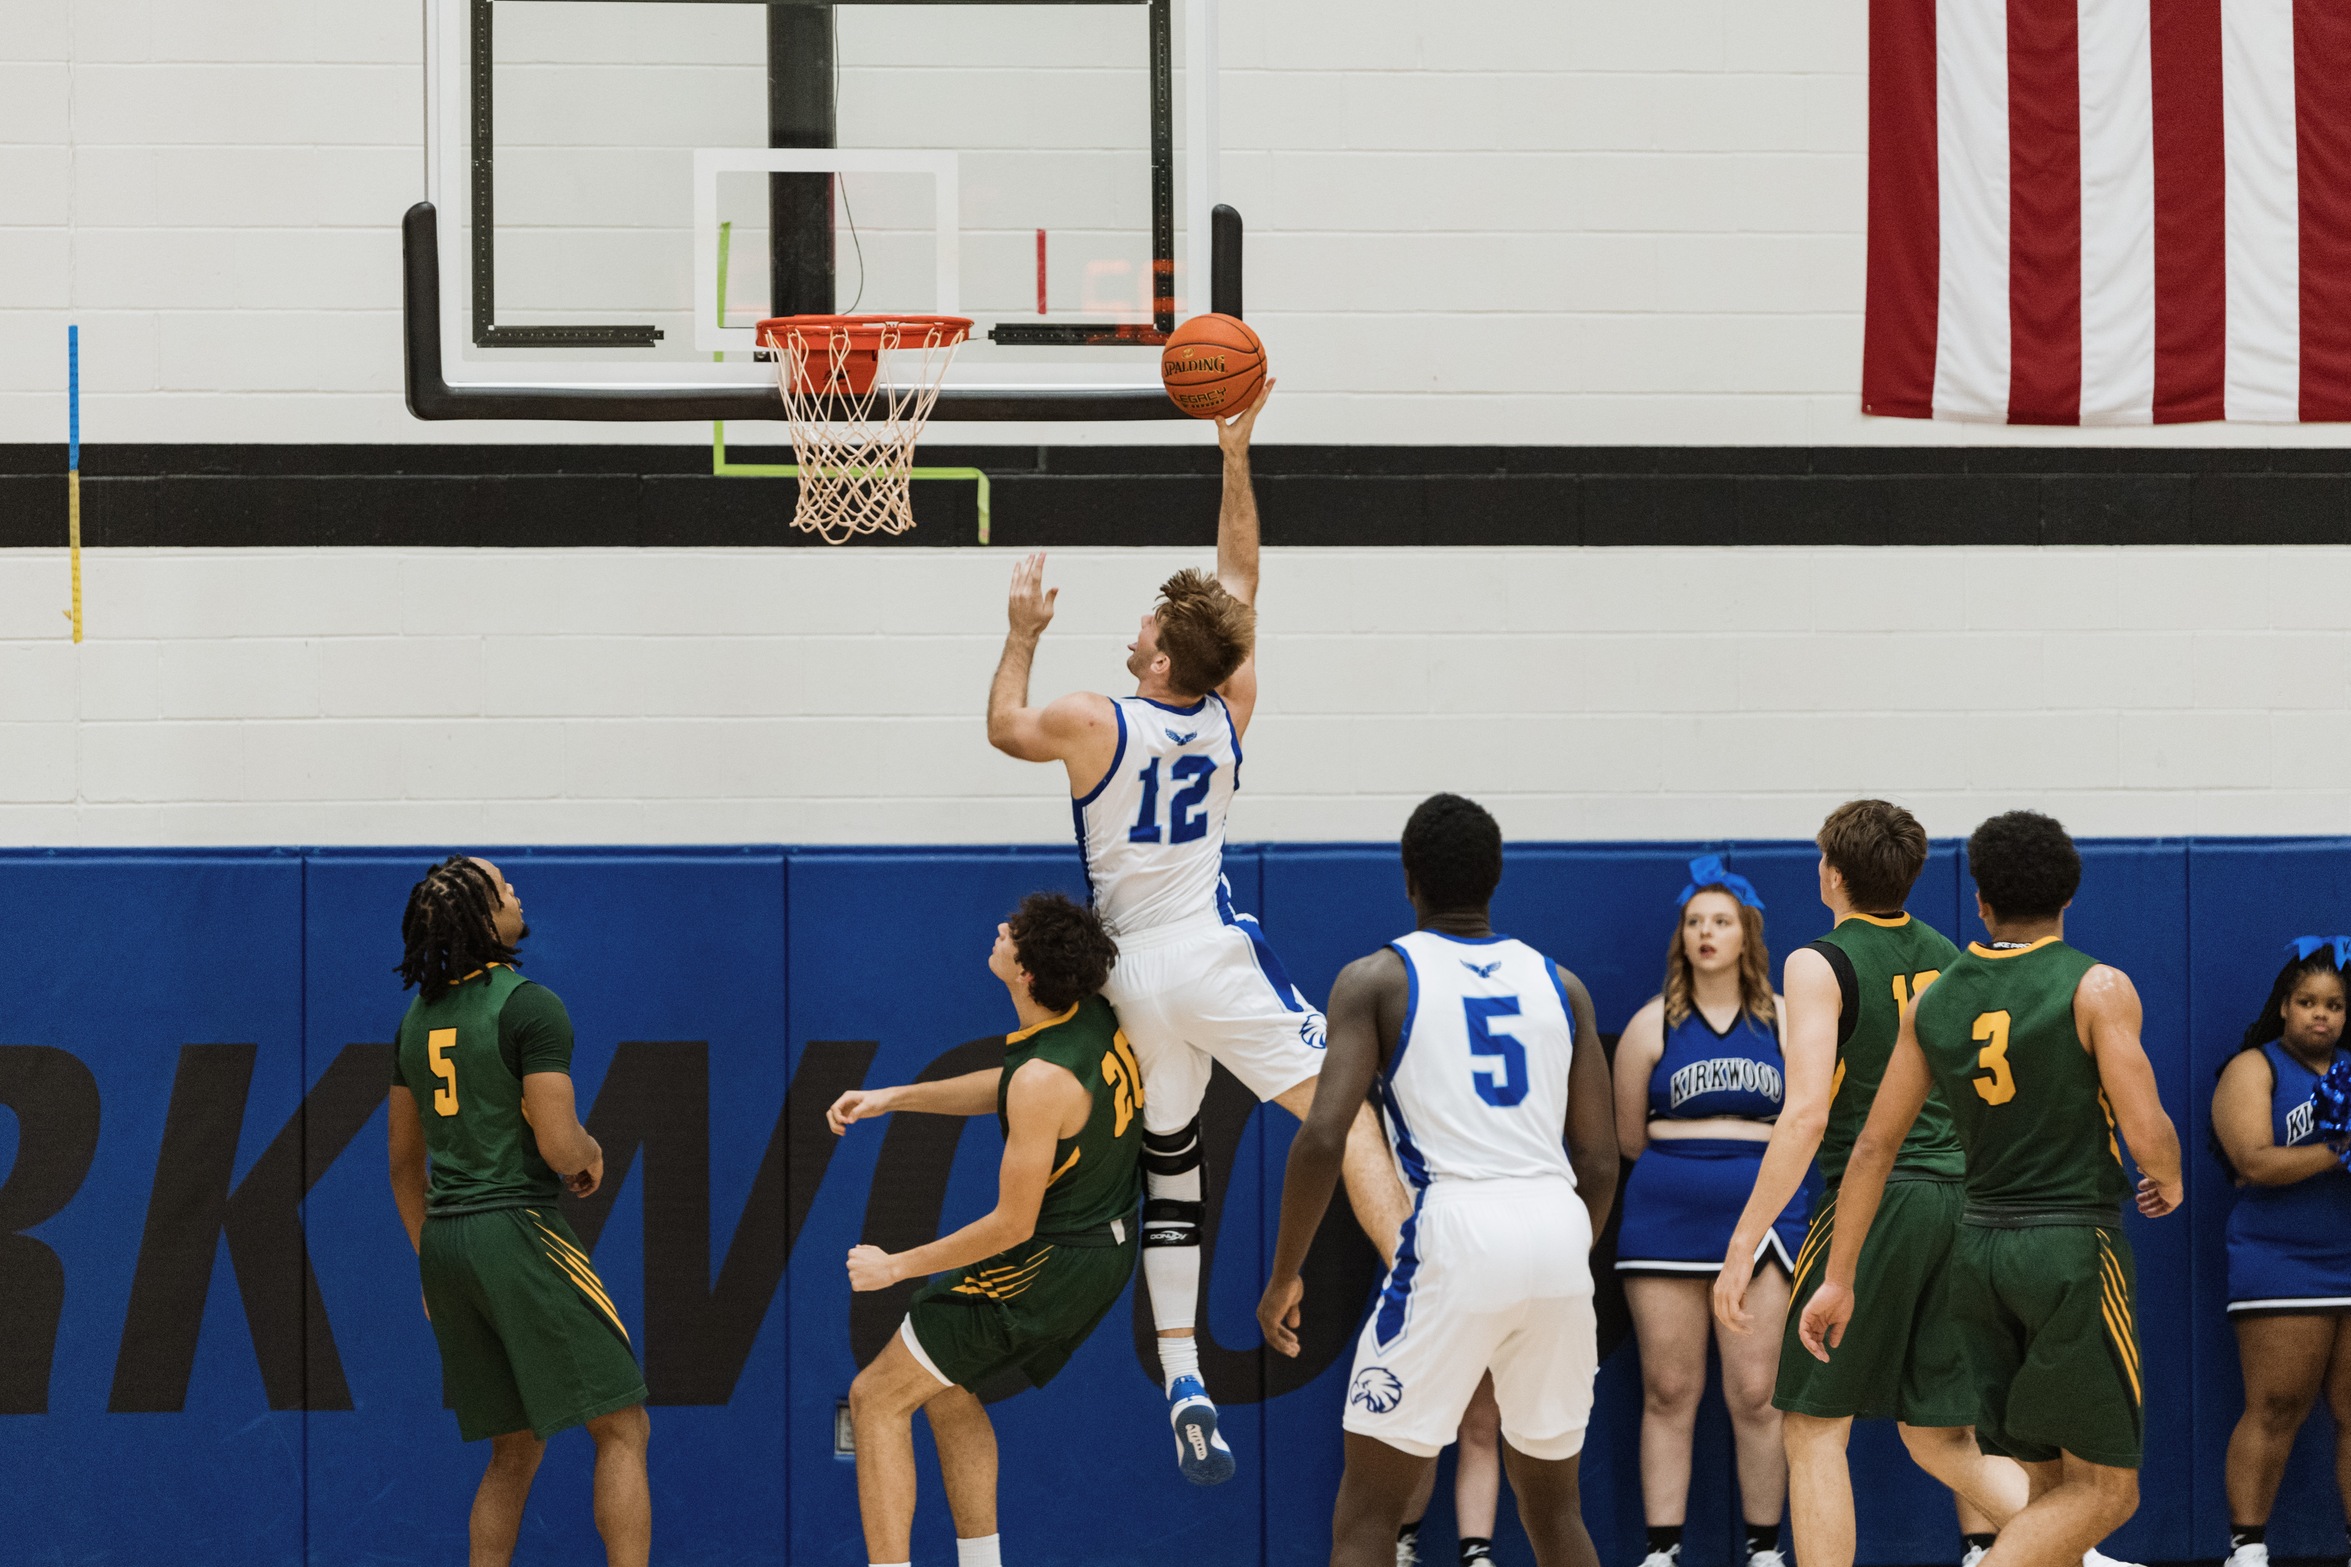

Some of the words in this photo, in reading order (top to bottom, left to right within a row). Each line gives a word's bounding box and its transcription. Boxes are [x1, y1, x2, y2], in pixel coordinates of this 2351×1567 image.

[1164, 354, 1226, 377] SPALDING
[1172, 387, 1227, 403] LEGACY
[1128, 754, 1219, 846] 12
[428, 1027, 460, 1117] 5
[1461, 994, 1530, 1109] 5
[1670, 1057, 1783, 1109] KIRKWOOD
[1972, 1009, 2016, 1106] 3
